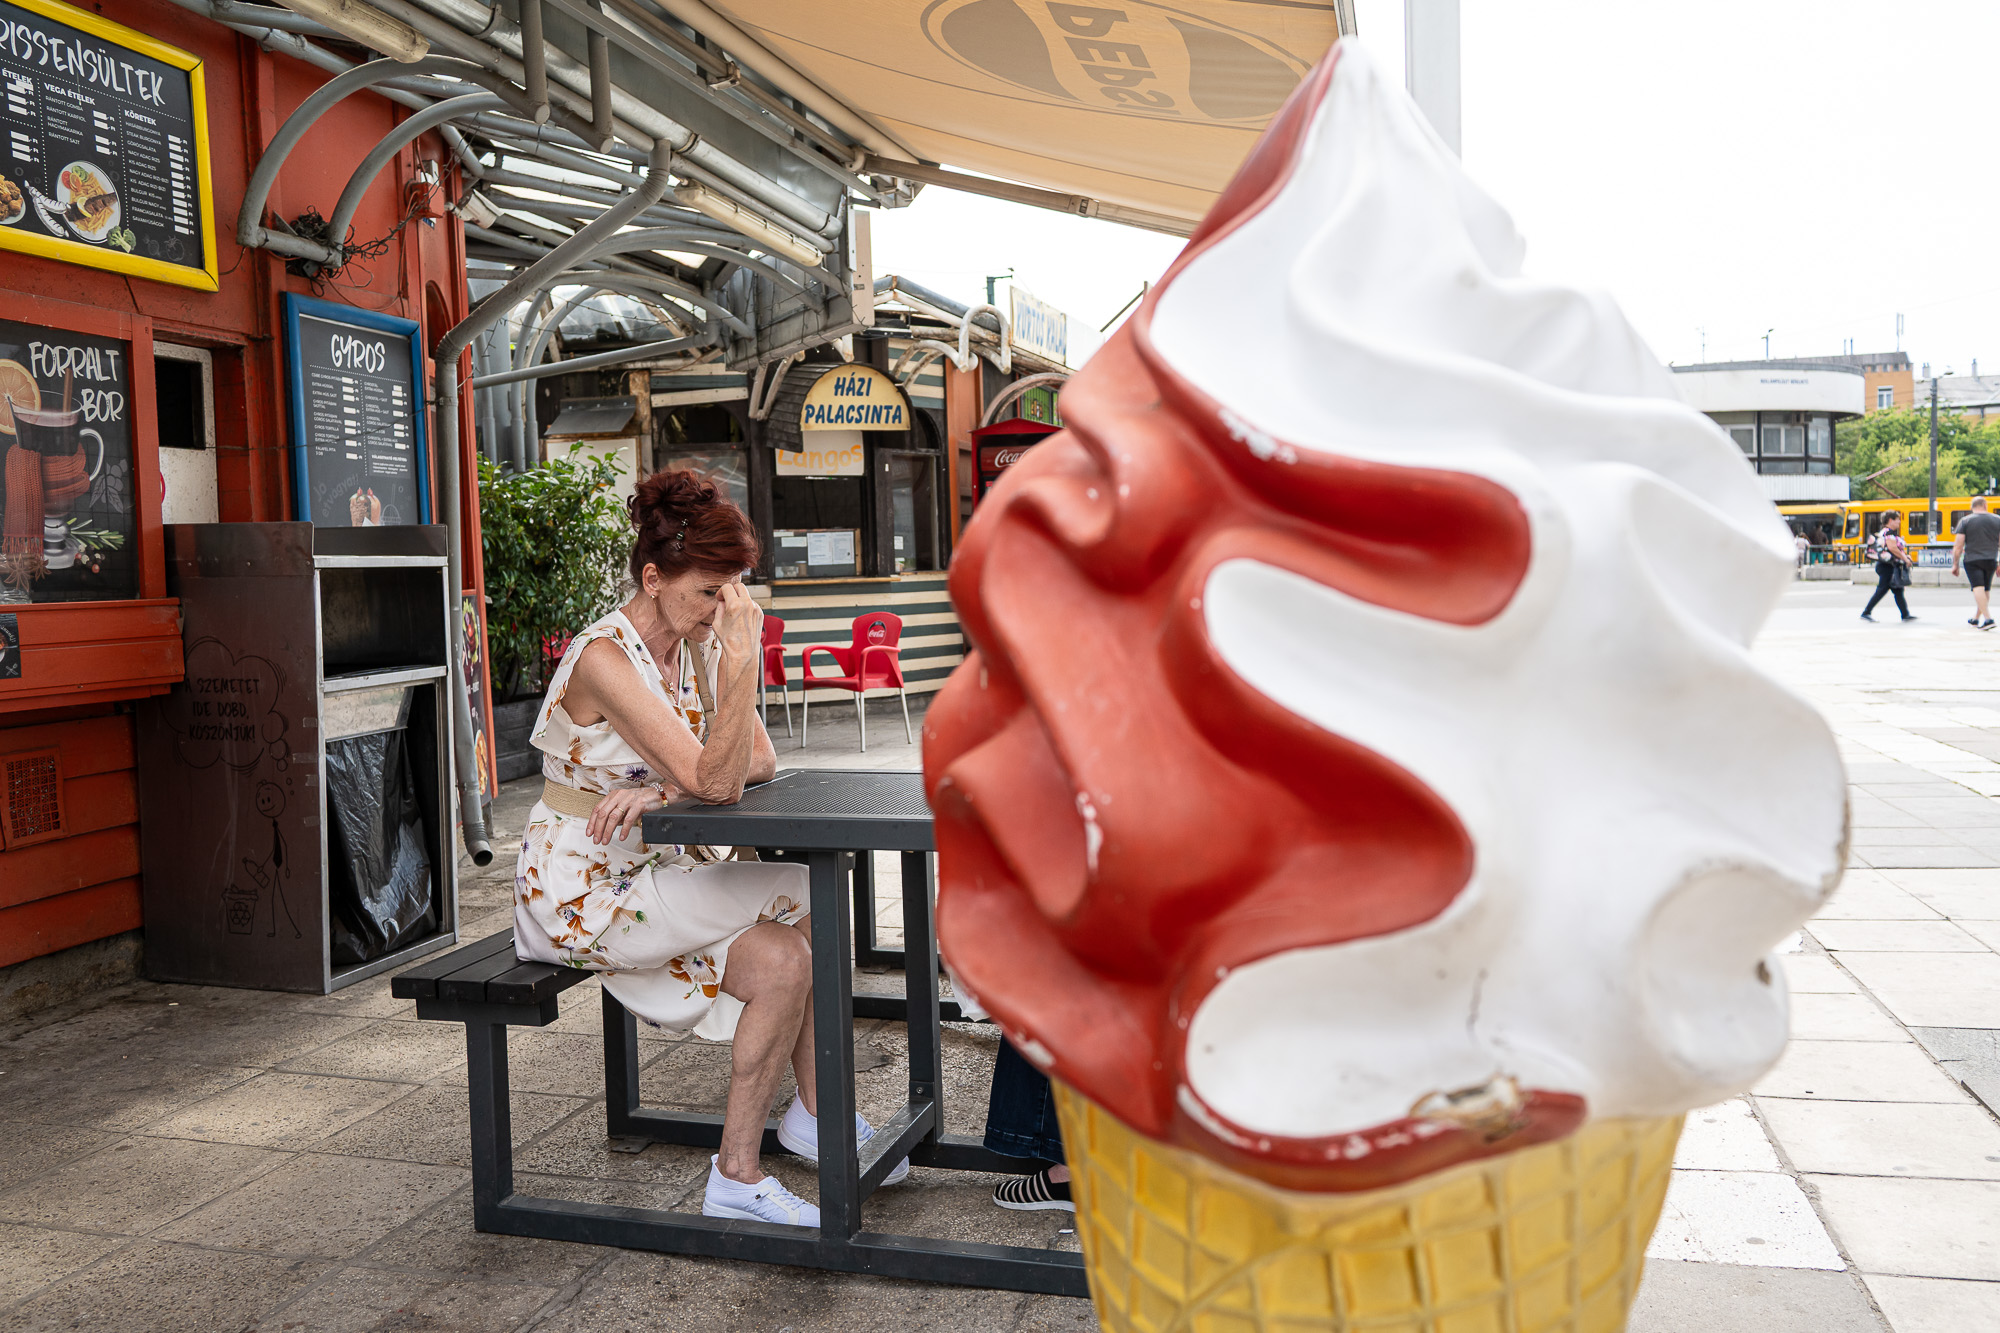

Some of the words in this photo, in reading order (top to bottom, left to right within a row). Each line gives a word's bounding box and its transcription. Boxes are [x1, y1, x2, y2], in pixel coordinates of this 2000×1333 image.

[44, 82, 66, 96] VEGA
[67, 89, 95, 105] ÉTELEK
[29, 342, 119, 381] FORRALT
[331, 334, 385, 373] GYROS
[834, 372, 872, 397] HÁZI
[81, 388, 124, 422] BOR
[805, 404, 902, 424] PALACSINTA
[185, 678, 192, 693] A
[197, 677, 259, 694] SZEMETET
[193, 702, 211, 716] IDE
